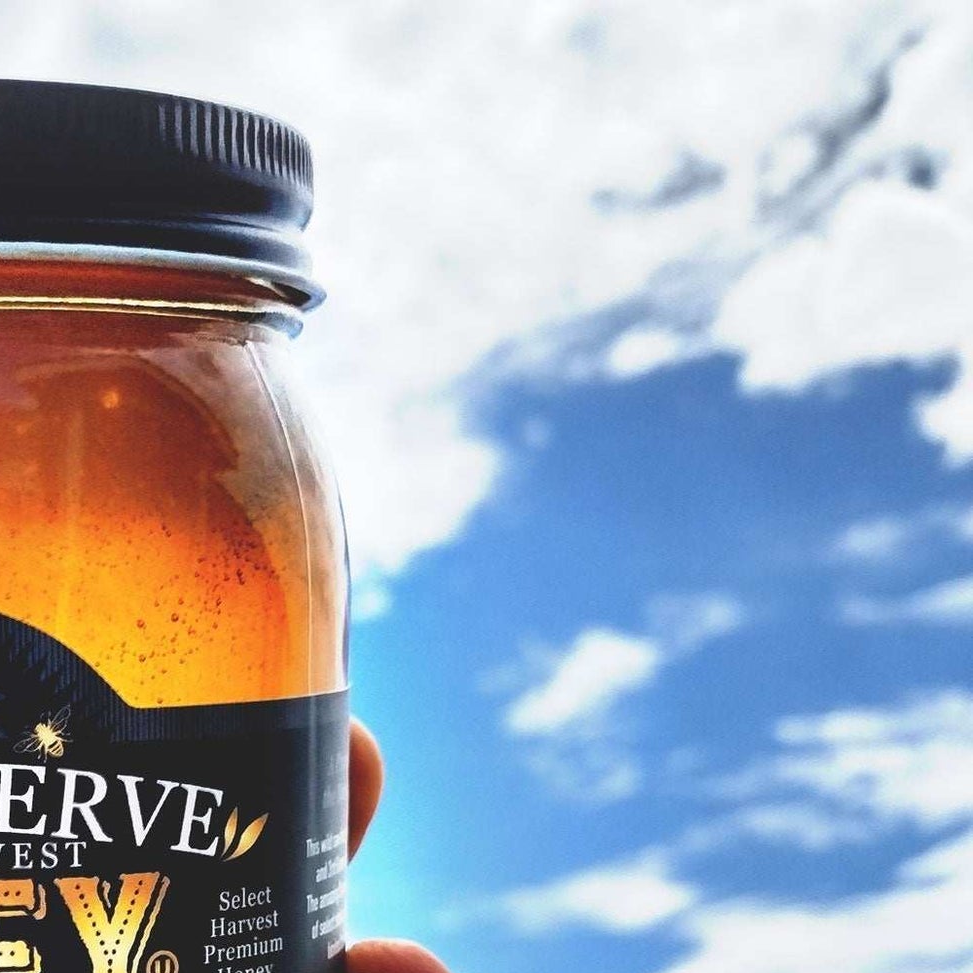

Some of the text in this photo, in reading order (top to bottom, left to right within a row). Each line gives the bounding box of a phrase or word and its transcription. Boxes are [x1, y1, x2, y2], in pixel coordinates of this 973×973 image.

[219, 886, 272, 911] Select
[210, 910, 279, 938] Harvest
[204, 936, 284, 964] Premium
